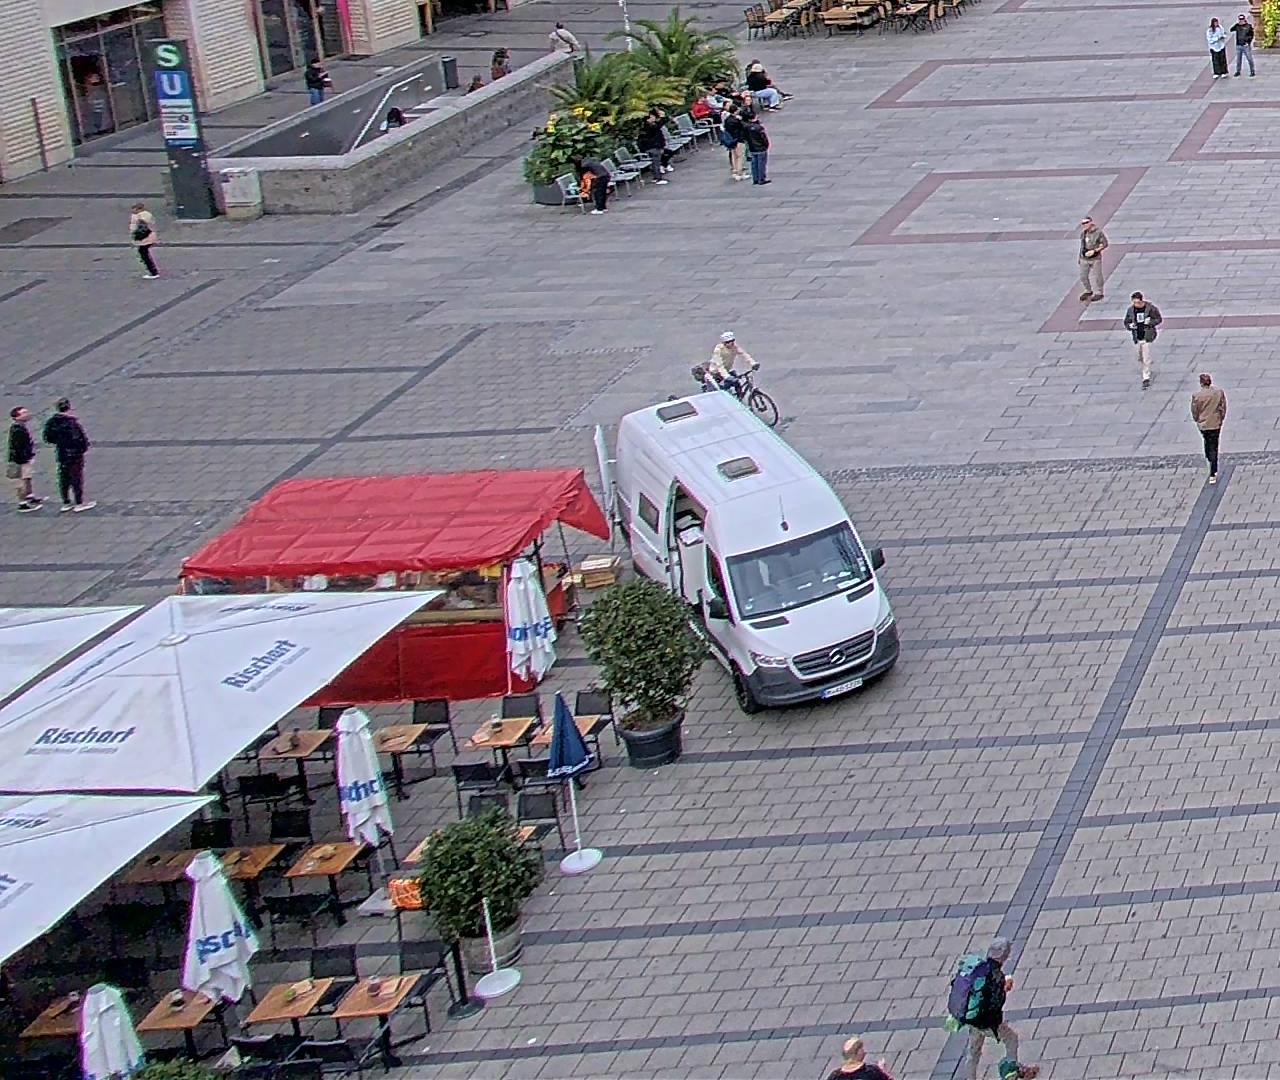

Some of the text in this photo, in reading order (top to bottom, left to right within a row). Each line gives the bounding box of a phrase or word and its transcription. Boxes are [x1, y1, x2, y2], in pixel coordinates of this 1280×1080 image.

[157, 44, 180, 67] S
[161, 73, 183, 96] U
[221, 638, 298, 689] Rischart
[35, 725, 137, 746] Rischart
